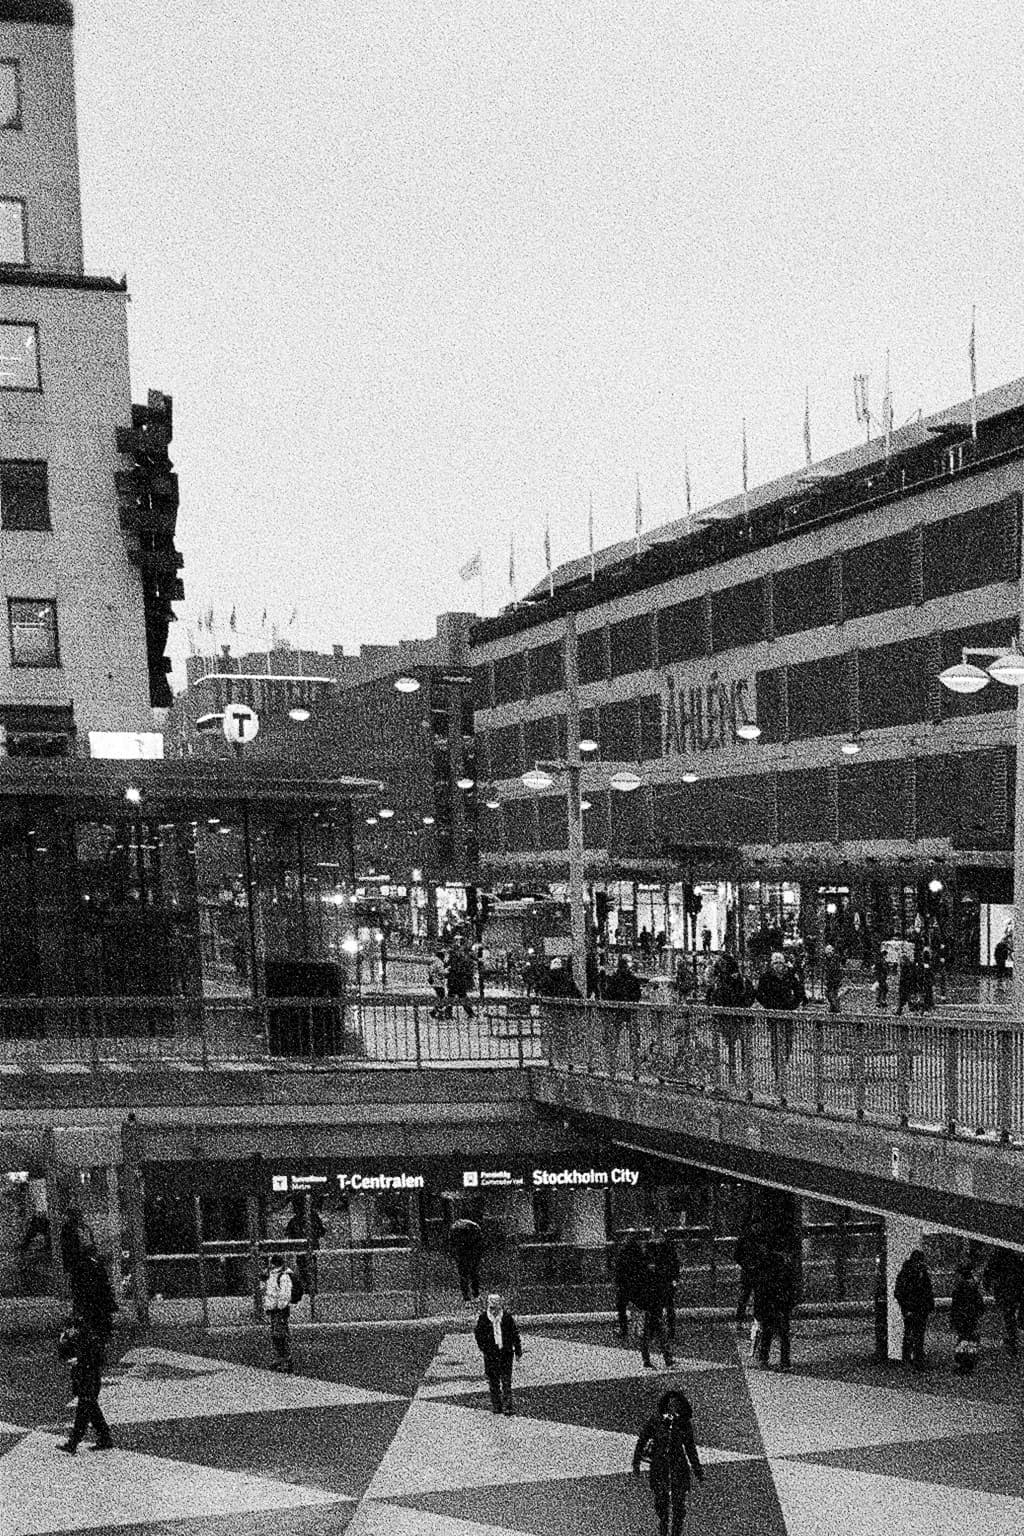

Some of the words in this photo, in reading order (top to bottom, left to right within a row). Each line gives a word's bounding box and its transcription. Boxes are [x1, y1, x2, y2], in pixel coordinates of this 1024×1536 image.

[337, 1173, 424, 1190] T-Centralen
[533, 1169, 608, 1186] Stockholm
[611, 1168, 639, 1186] City
